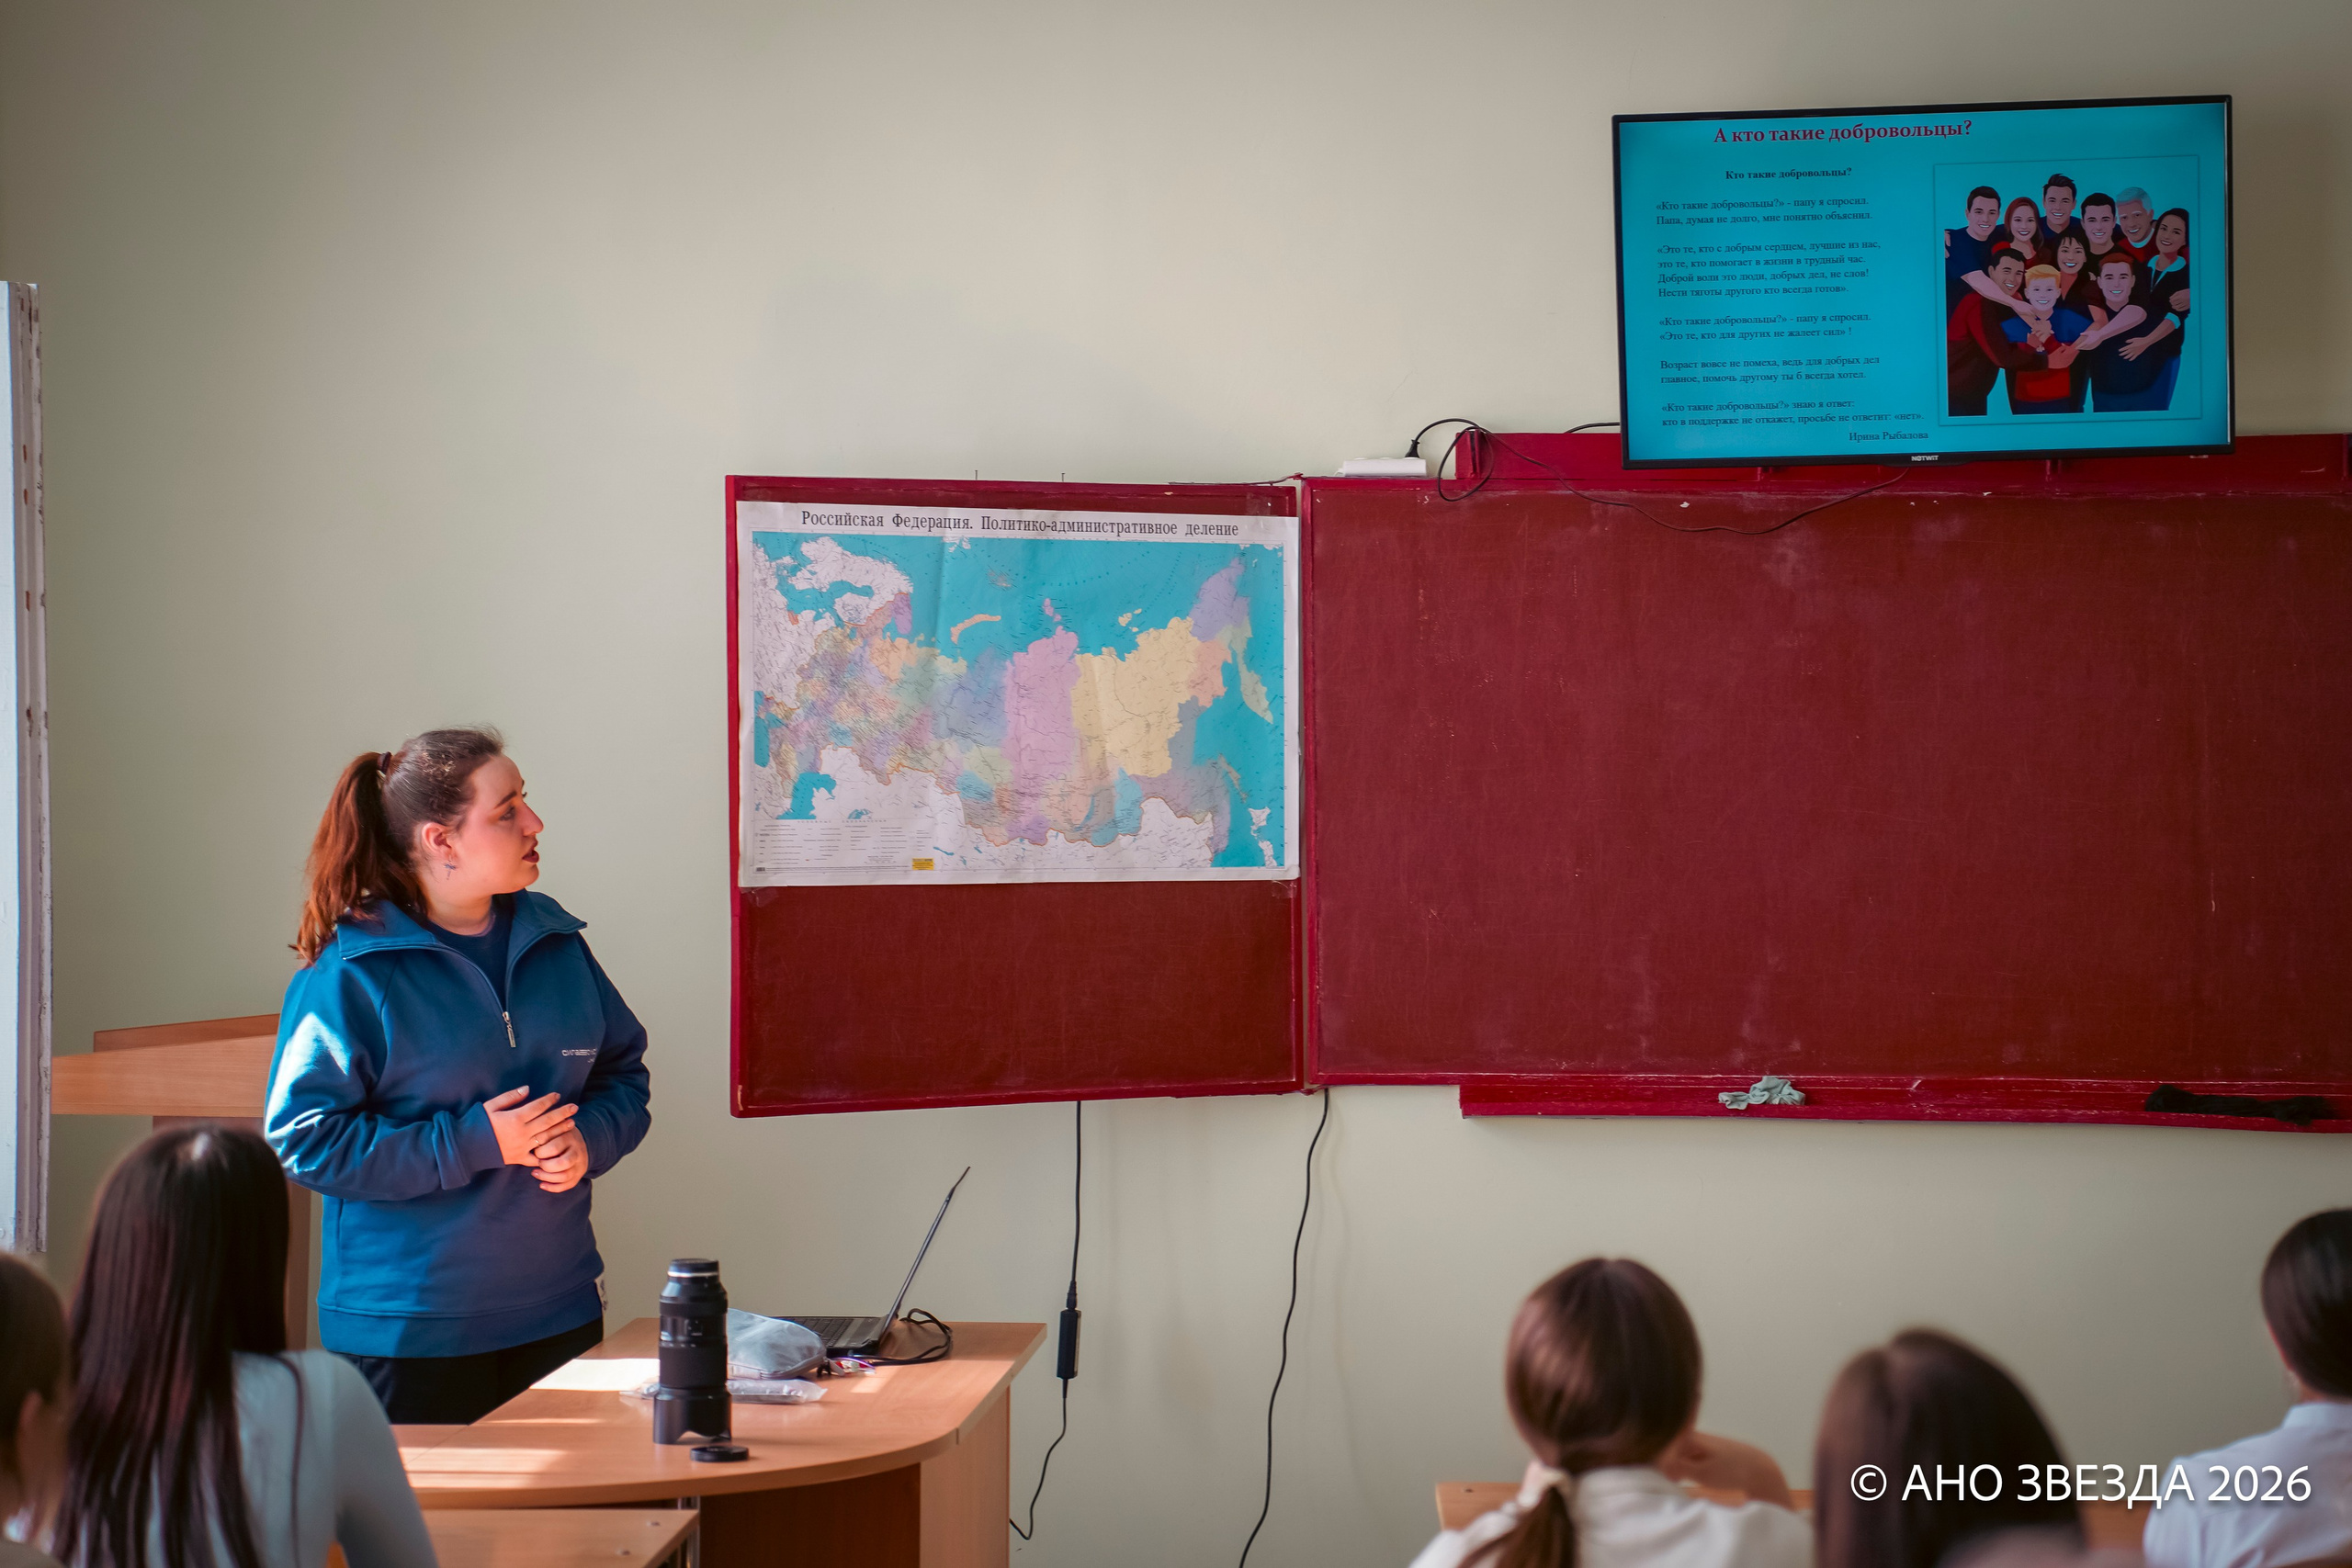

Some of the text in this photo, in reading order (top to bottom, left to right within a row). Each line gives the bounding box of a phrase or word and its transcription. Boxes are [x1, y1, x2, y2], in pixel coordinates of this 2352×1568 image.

[1712, 119, 1973, 142] А кто такие добровольцы?
[1725, 167, 1851, 180] Кто такие добровольцы?
[1656, 200, 1679, 210] «Кто
[1710, 197, 1785, 211] добровольцы?»
[1792, 199, 1816, 209] папу
[1826, 197, 1869, 209] спросил.
[1656, 215, 1683, 226] Папа,
[1684, 216, 1714, 227] думая
[1729, 215, 1760, 225] долго,
[1761, 214, 1781, 222] мне
[1782, 213, 1823, 221] понятно
[1825, 210, 1872, 220] объяснил.
[1657, 244, 1681, 254] «Это
[1682, 246, 1696, 254] те,
[1724, 243, 1762, 254] добрым
[1763, 243, 1807, 254] сердцем,
[1808, 242, 1846, 253] лучшие
[1860, 241, 1881, 250] нас,
[1674, 260, 1689, 269] те,
[1762, 257, 1793, 265] жизни
[1803, 254, 1845, 267] трудный
[1657, 273, 1694, 285] Доброй
[1696, 274, 1719, 282] воли
[1738, 273, 1768, 282] люди,
[1769, 270, 1806, 282] добрых
[1807, 271, 1827, 281] дел,
[1843, 268, 1869, 278] слов!
[1657, 288, 1688, 297] Нести
[1689, 288, 1722, 297] тяготы
[1724, 288, 1761, 299] другого
[1781, 287, 1813, 296] всегда
[1658, 316, 1682, 326] «Кто
[1713, 313, 1787, 327] добровольцы?»
[1796, 315, 1819, 325] папу
[1828, 314, 1871, 324] спросил.
[1658, 331, 1683, 341] «Это
[1684, 333, 1699, 342] те,
[1718, 332, 1736, 341] для
[1737, 331, 1771, 341] других
[1786, 329, 1821, 337] жалеет
[1660, 360, 1698, 372] Возраст
[1742, 359, 1780, 368] помеха,
[1781, 359, 1804, 368] ведь
[1804, 358, 1822, 367] для
[1824, 355, 1860, 367] добрых
[1862, 357, 1880, 367] дел
[1660, 376, 1700, 385] главное,
[1738, 373, 1779, 384] другому
[1795, 370, 1803, 380] б
[1804, 372, 1836, 381] всегда
[1837, 371, 1866, 379] хотел.
[1661, 402, 1685, 412] «Кто
[1686, 403, 1713, 412] такие
[1715, 400, 1790, 412] добровольцы?»
[1791, 400, 1816, 409] знаю
[1826, 400, 1855, 408] ответ:
[1688, 417, 1739, 427] поддержке
[1754, 416, 1795, 424] откажет,
[1796, 412, 1837, 425] просьбе
[1850, 413, 1892, 422] ответит:
[1894, 412, 1925, 421] «нет».
[1848, 431, 1929, 444] Ирина Рыбалова
[801, 511, 1238, 538] Российская Федерация. Политико-административное деление
